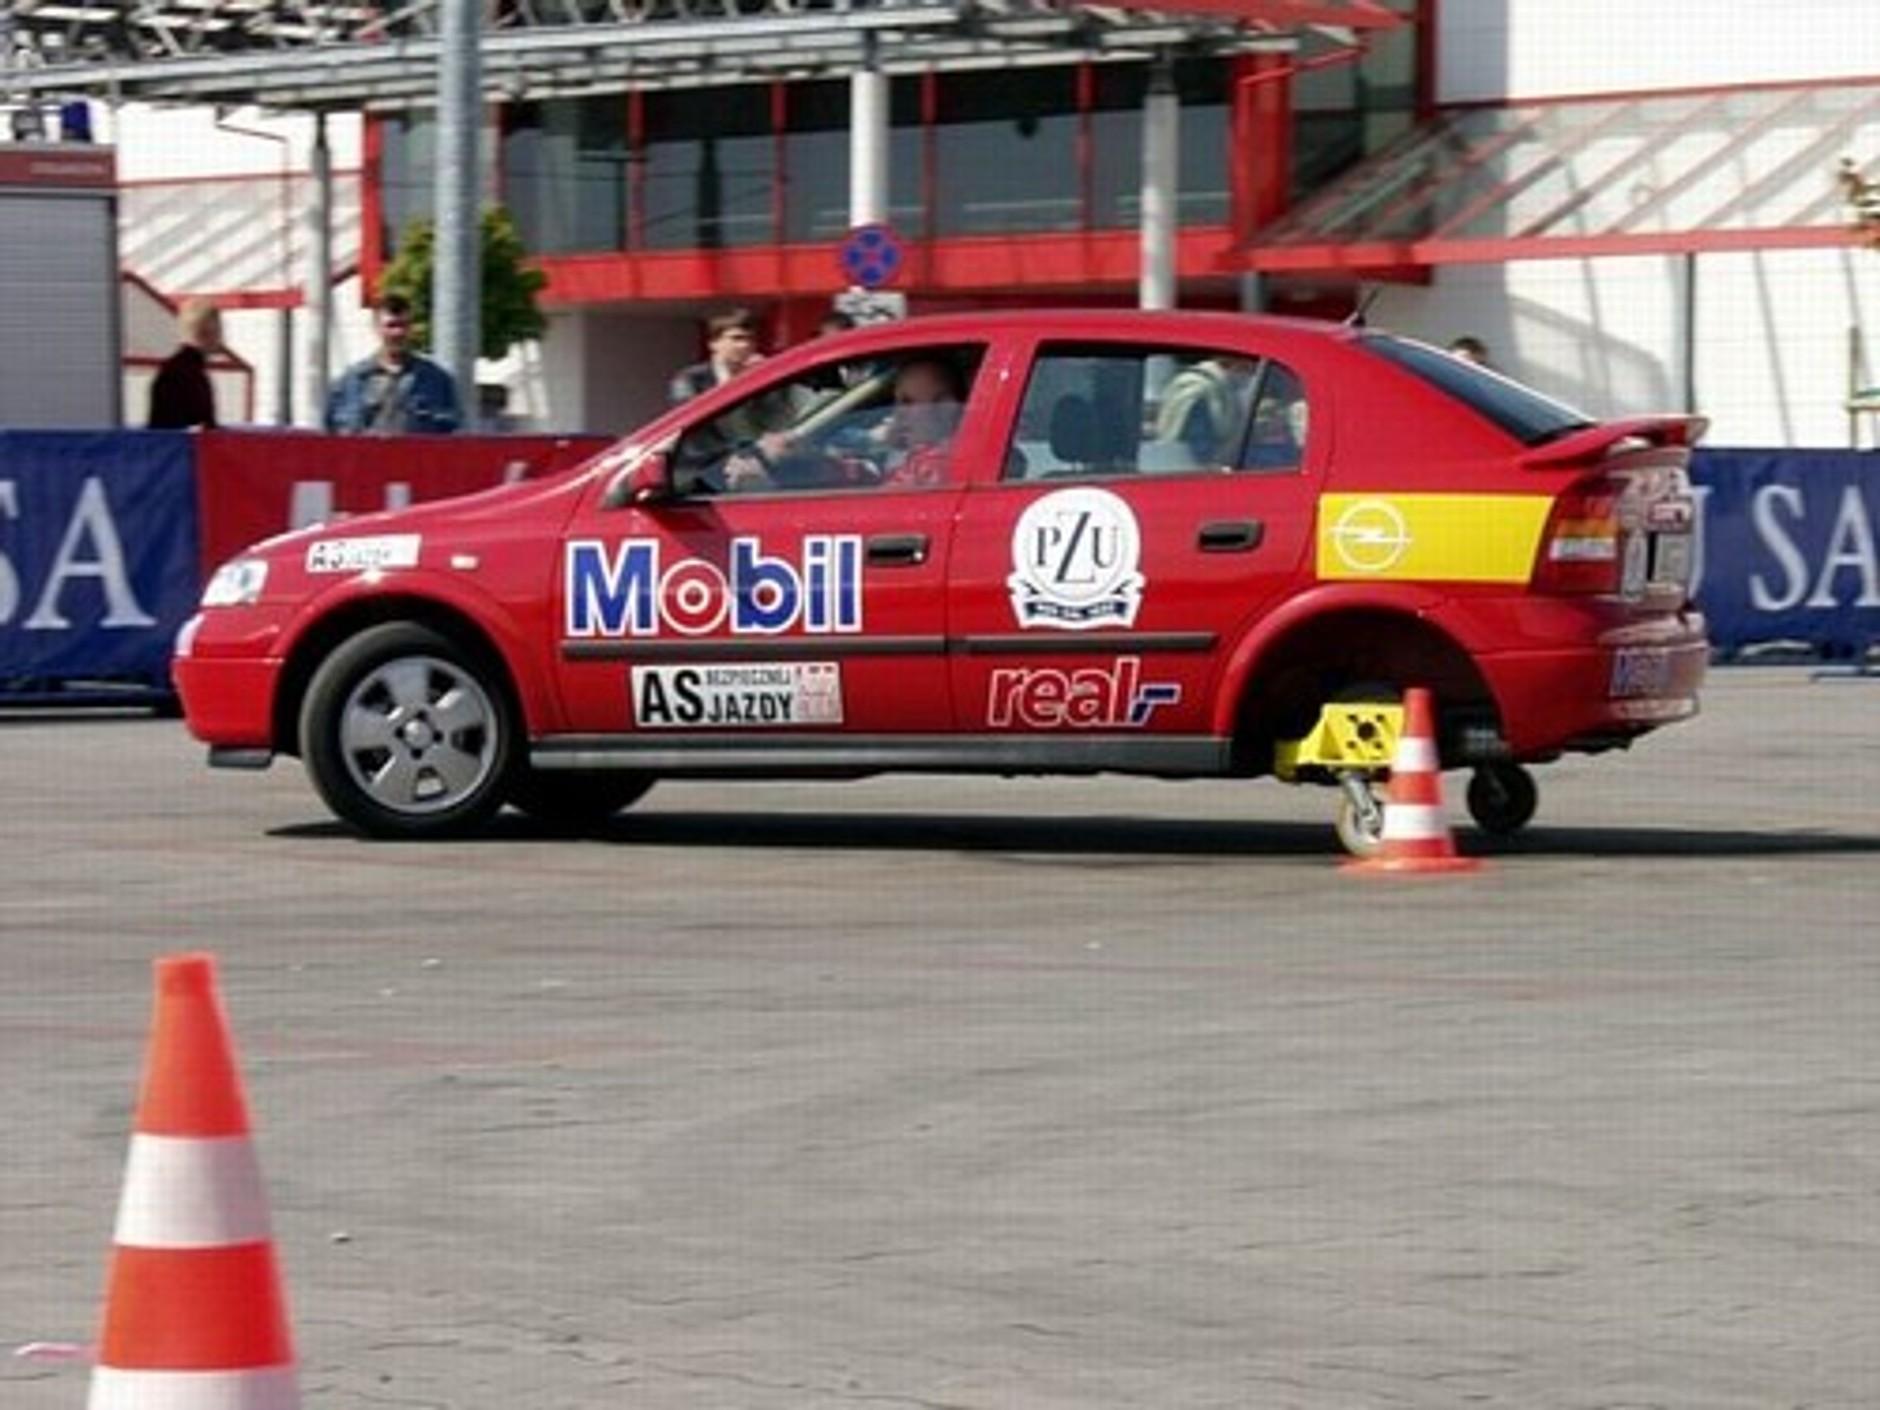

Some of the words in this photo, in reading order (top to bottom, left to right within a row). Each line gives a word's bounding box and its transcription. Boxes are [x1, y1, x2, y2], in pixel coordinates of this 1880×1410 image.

[0, 476, 157, 629] A
[566, 534, 862, 636] Mobil
[1036, 511, 1118, 584] PZU
[1748, 484, 1880, 610] SA
[639, 670, 704, 723] AS
[706, 691, 793, 722] JAZDY
